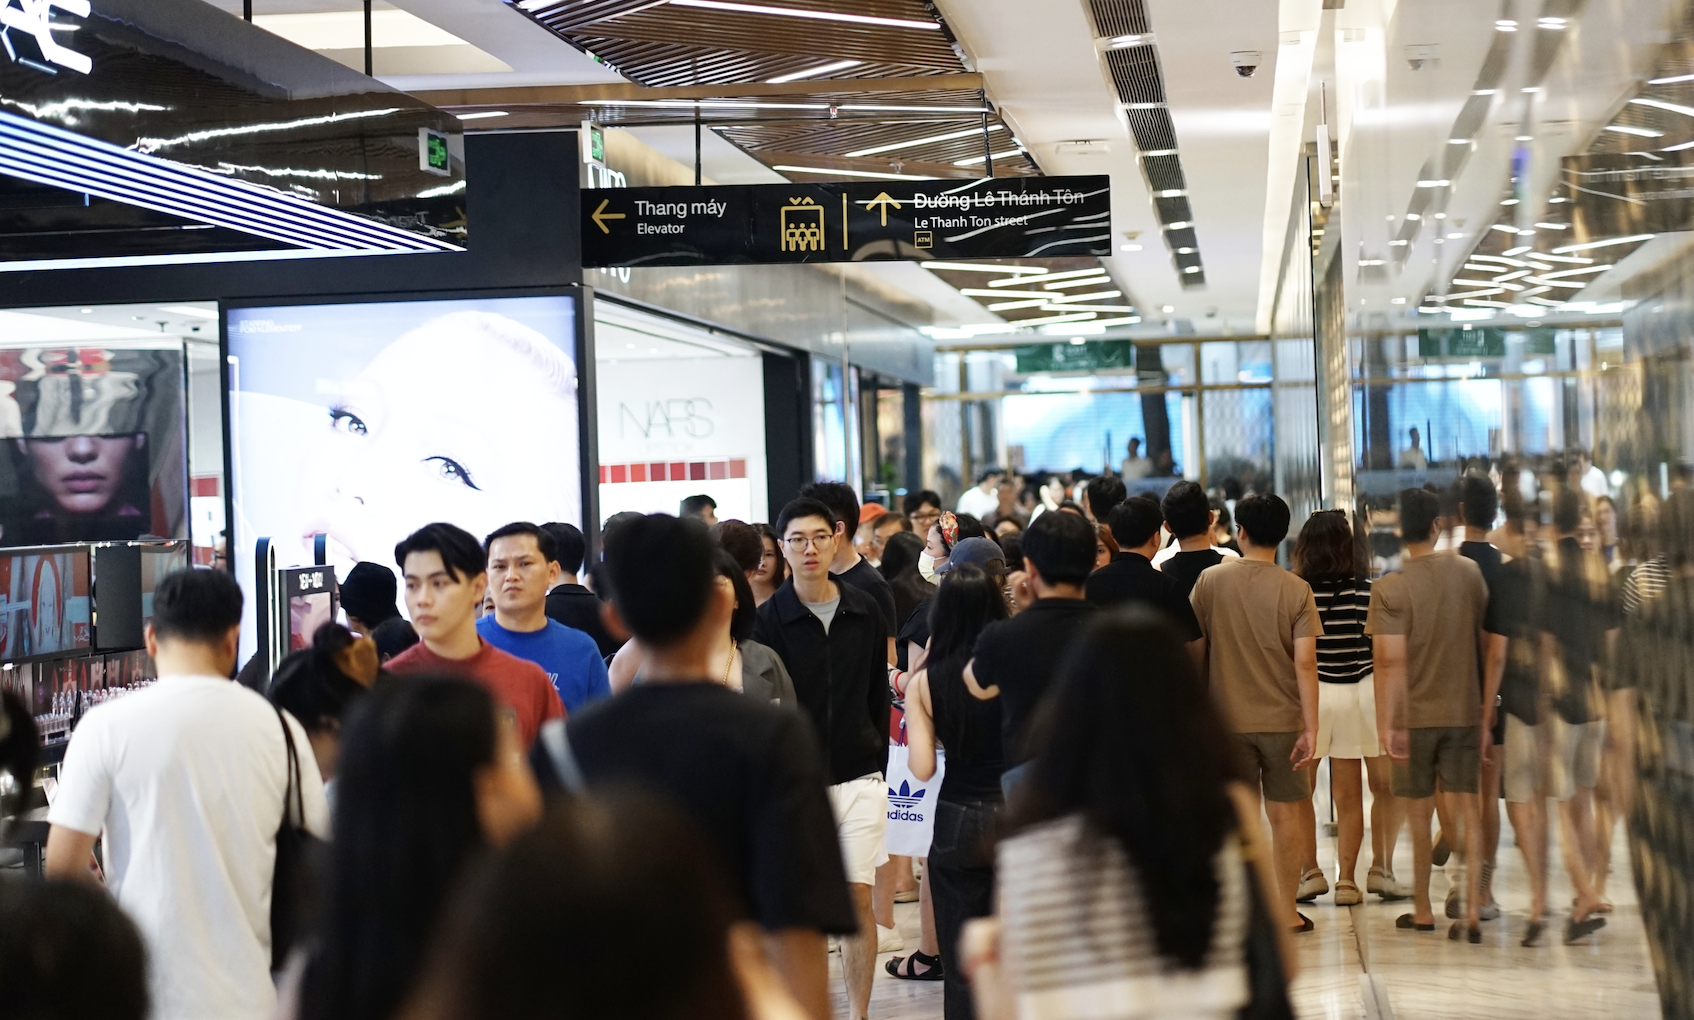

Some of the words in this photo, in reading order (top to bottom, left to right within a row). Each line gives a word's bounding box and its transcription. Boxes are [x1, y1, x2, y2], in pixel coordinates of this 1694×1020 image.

[914, 192, 970, 211] Đường
[974, 191, 996, 207] Lê
[997, 189, 1051, 207] Thánh
[1052, 188, 1085, 205] Tôn
[634, 200, 687, 219] Thang
[691, 198, 727, 218] máy
[637, 223, 685, 235] Elevator
[914, 217, 929, 229] Le
[930, 216, 968, 228] Thanh
[969, 216, 992, 228] Ton
[995, 215, 1029, 227] street
[618, 396, 715, 440] NARS
[887, 810, 923, 821] didas
